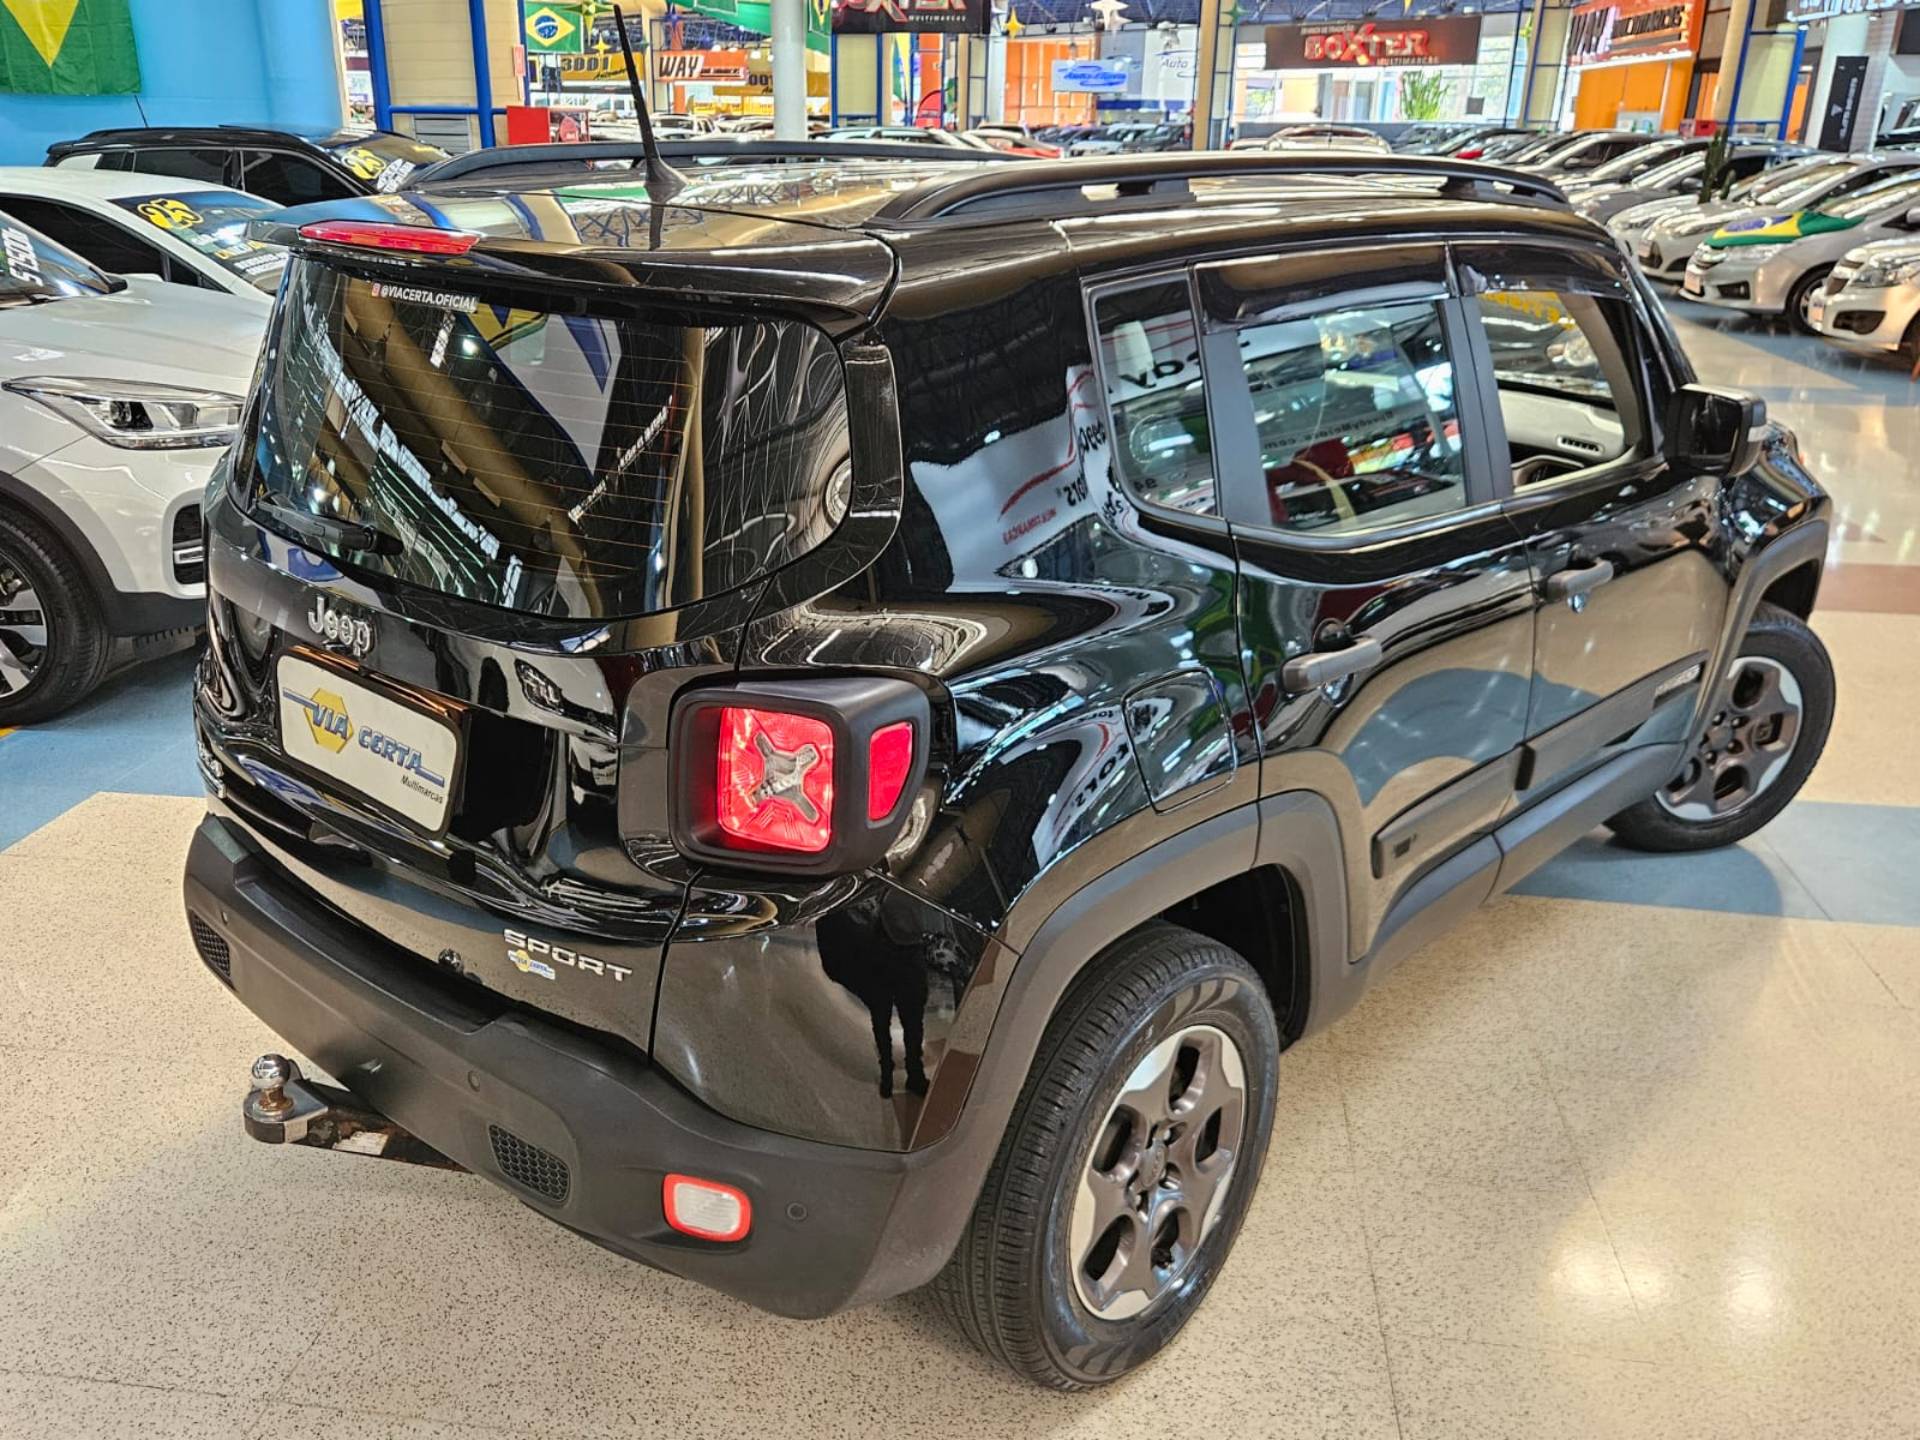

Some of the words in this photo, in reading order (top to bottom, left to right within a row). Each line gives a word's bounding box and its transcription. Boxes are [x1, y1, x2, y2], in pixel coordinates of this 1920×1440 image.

[1304, 23, 1428, 66] BOXTER
[659, 56, 699, 78] WAY
[138, 199, 204, 229] 25
[381, 285, 477, 311] @VIACERTA.OFICIAL
[307, 596, 373, 657] Jeep
[313, 703, 349, 740] VIA
[358, 725, 424, 771] CERTA
[401, 775, 444, 805] Multimarcas
[504, 928, 633, 982] SPORT
